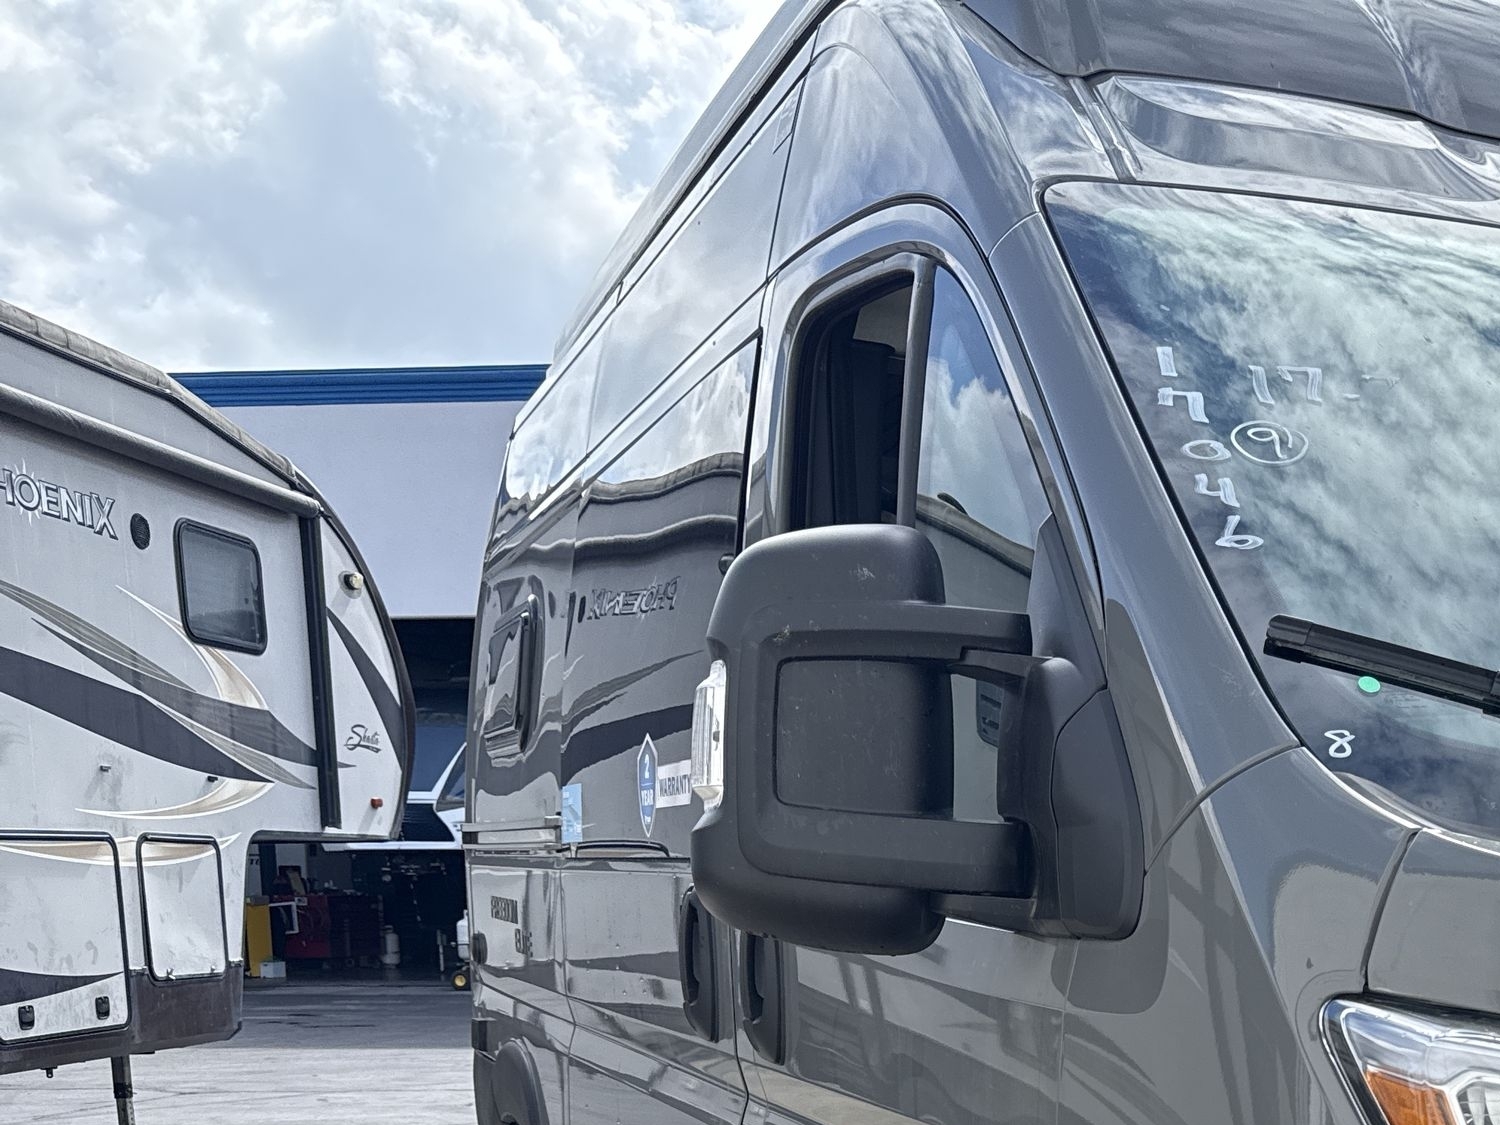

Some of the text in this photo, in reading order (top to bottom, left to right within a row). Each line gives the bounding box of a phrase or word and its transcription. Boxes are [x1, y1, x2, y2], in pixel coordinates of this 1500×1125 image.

[1323, 729, 1355, 758] 8
[644, 753, 650, 779] 2
[641, 788, 653, 806] YEAR
